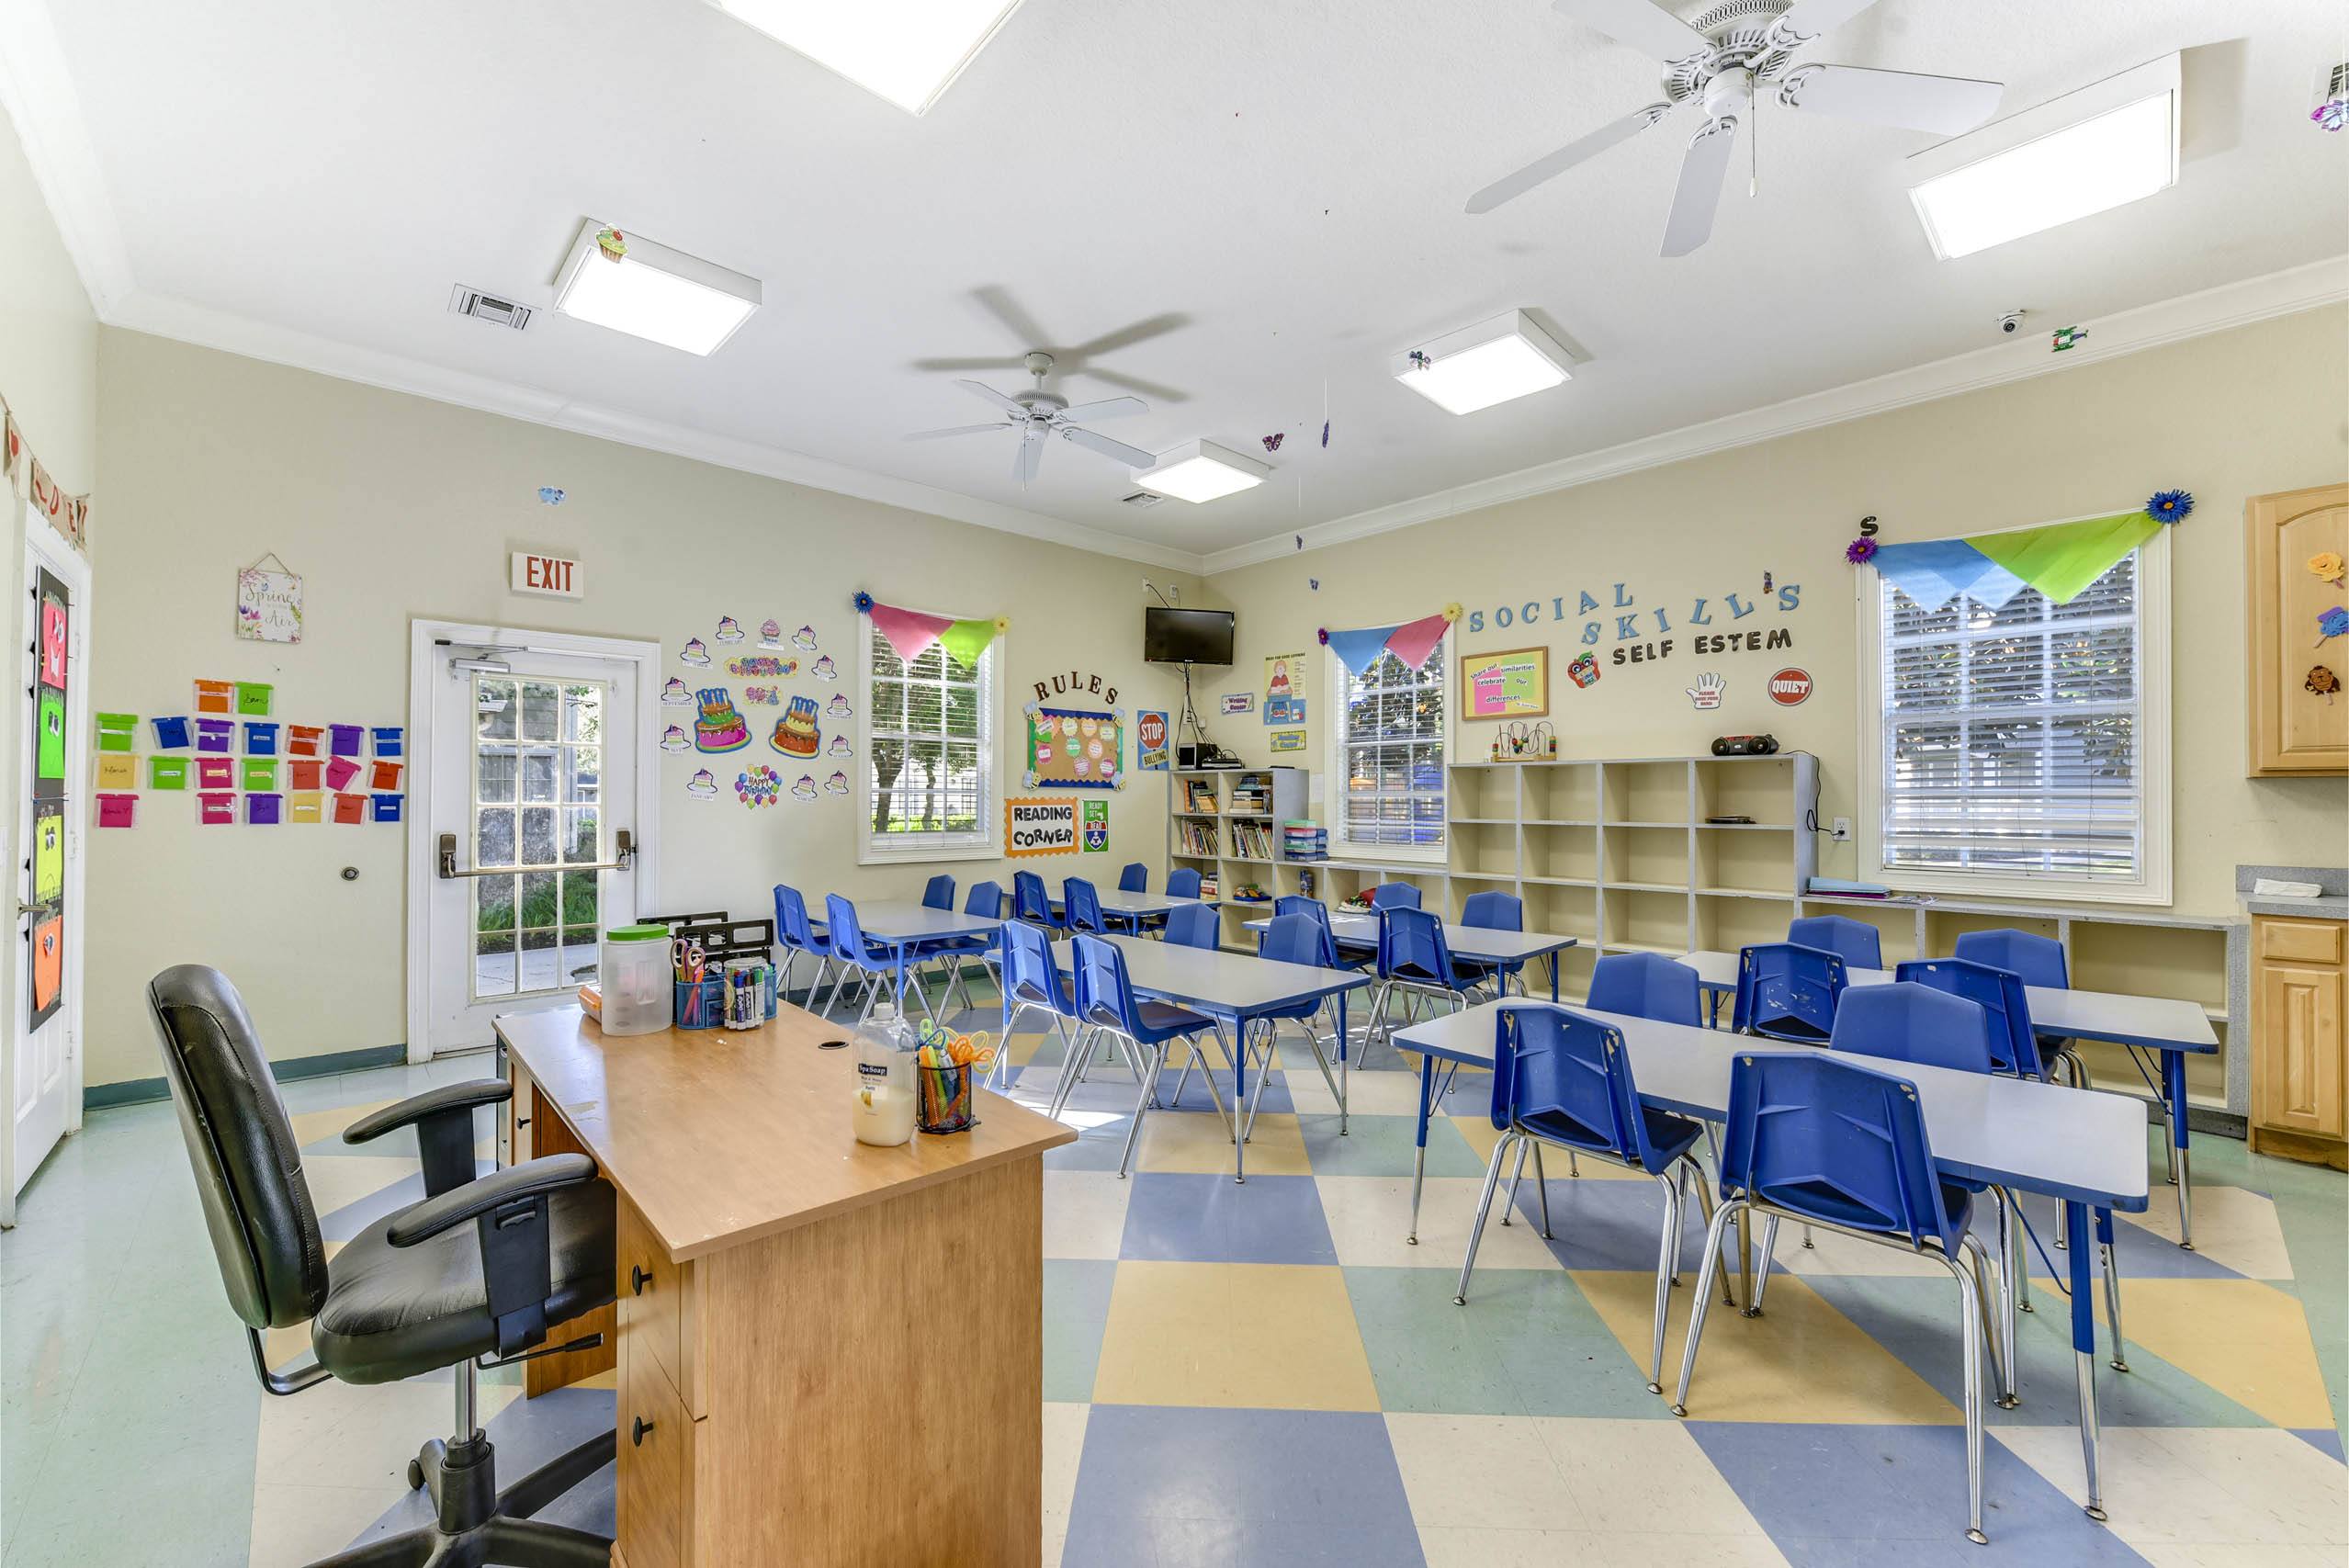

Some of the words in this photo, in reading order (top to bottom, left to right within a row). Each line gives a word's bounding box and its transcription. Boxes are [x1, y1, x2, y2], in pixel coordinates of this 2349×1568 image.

[527, 556, 573, 592] EXIT
[1469, 582, 1633, 632] SOCIAL
[1612, 638, 1673, 665] SELF
[1694, 627, 1792, 654] ESTEM
[1500, 663, 1535, 672] similarities
[1033, 671, 1118, 705] RULES
[1477, 677, 1506, 686] celebrate
[1771, 680, 1809, 694] QUIET
[1485, 694, 1520, 703] differences
[1141, 722, 1163, 740] STOP
[1144, 750, 1167, 765] BULLYING
[749, 776, 770, 786] HAPPY
[1013, 807, 1073, 822] READING
[1013, 828, 1073, 847] CORNER
